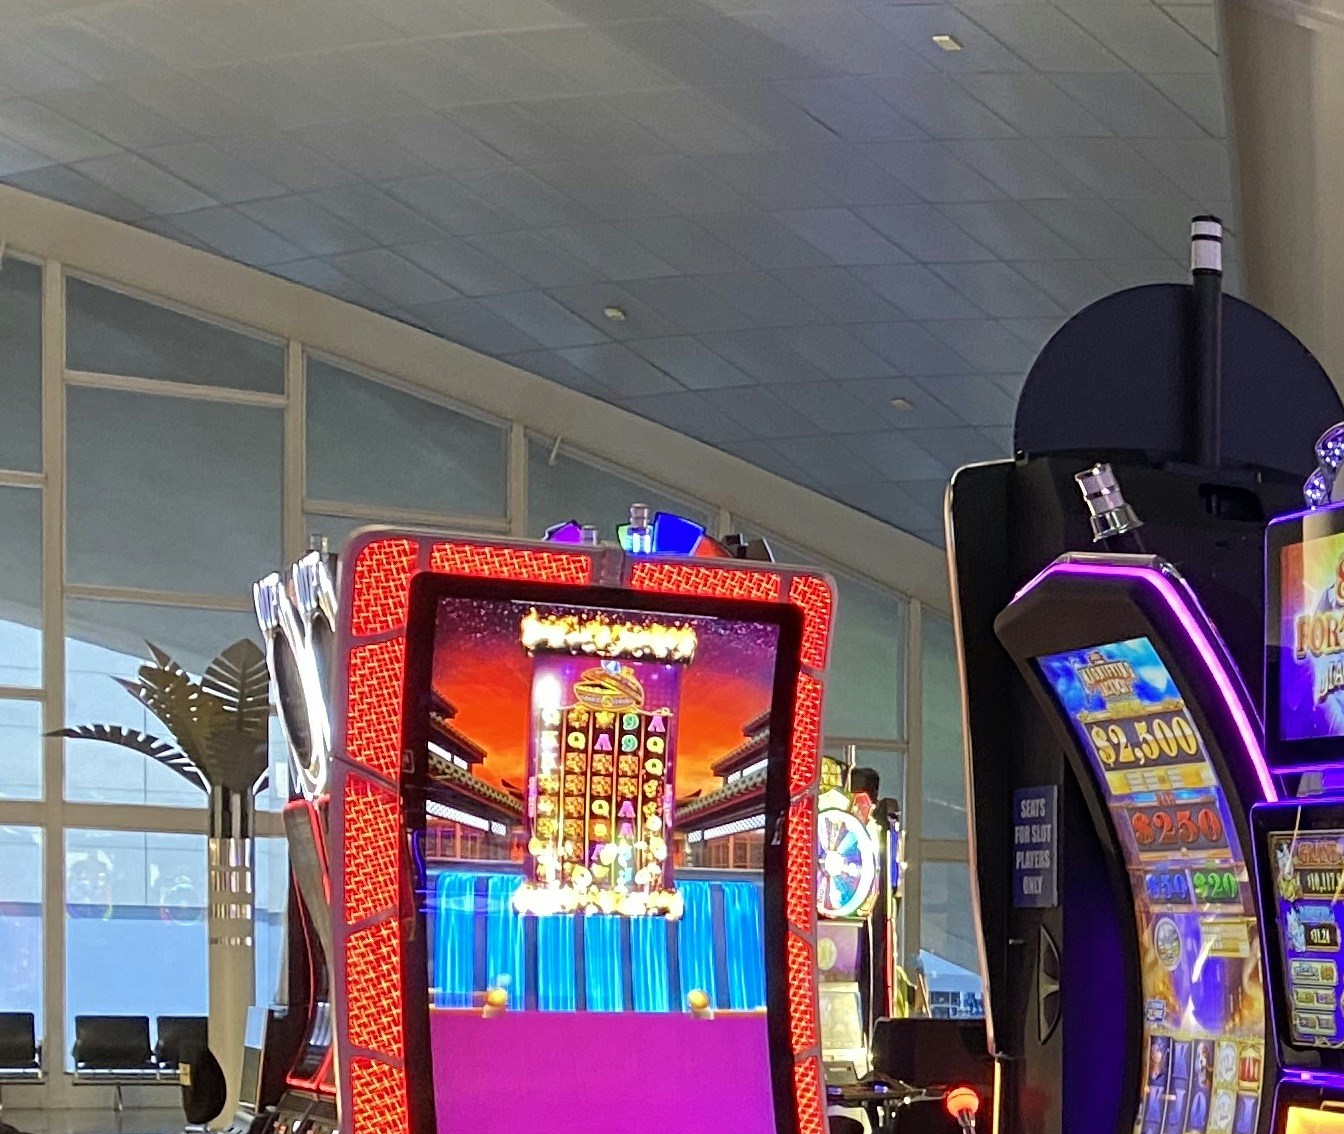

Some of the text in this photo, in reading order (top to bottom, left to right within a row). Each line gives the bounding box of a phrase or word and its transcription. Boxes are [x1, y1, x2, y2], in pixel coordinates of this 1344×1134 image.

[1091, 716, 1199, 767] $2,500
[1020, 798, 1046, 819] SEATS
[1014, 824, 1051, 845] FOR SLOT
[1131, 808, 1224, 845] $250
[1016, 850, 1051, 870] PLAYERS
[1022, 875, 1043, 896] ONLY
[1192, 871, 1239, 899] $20
